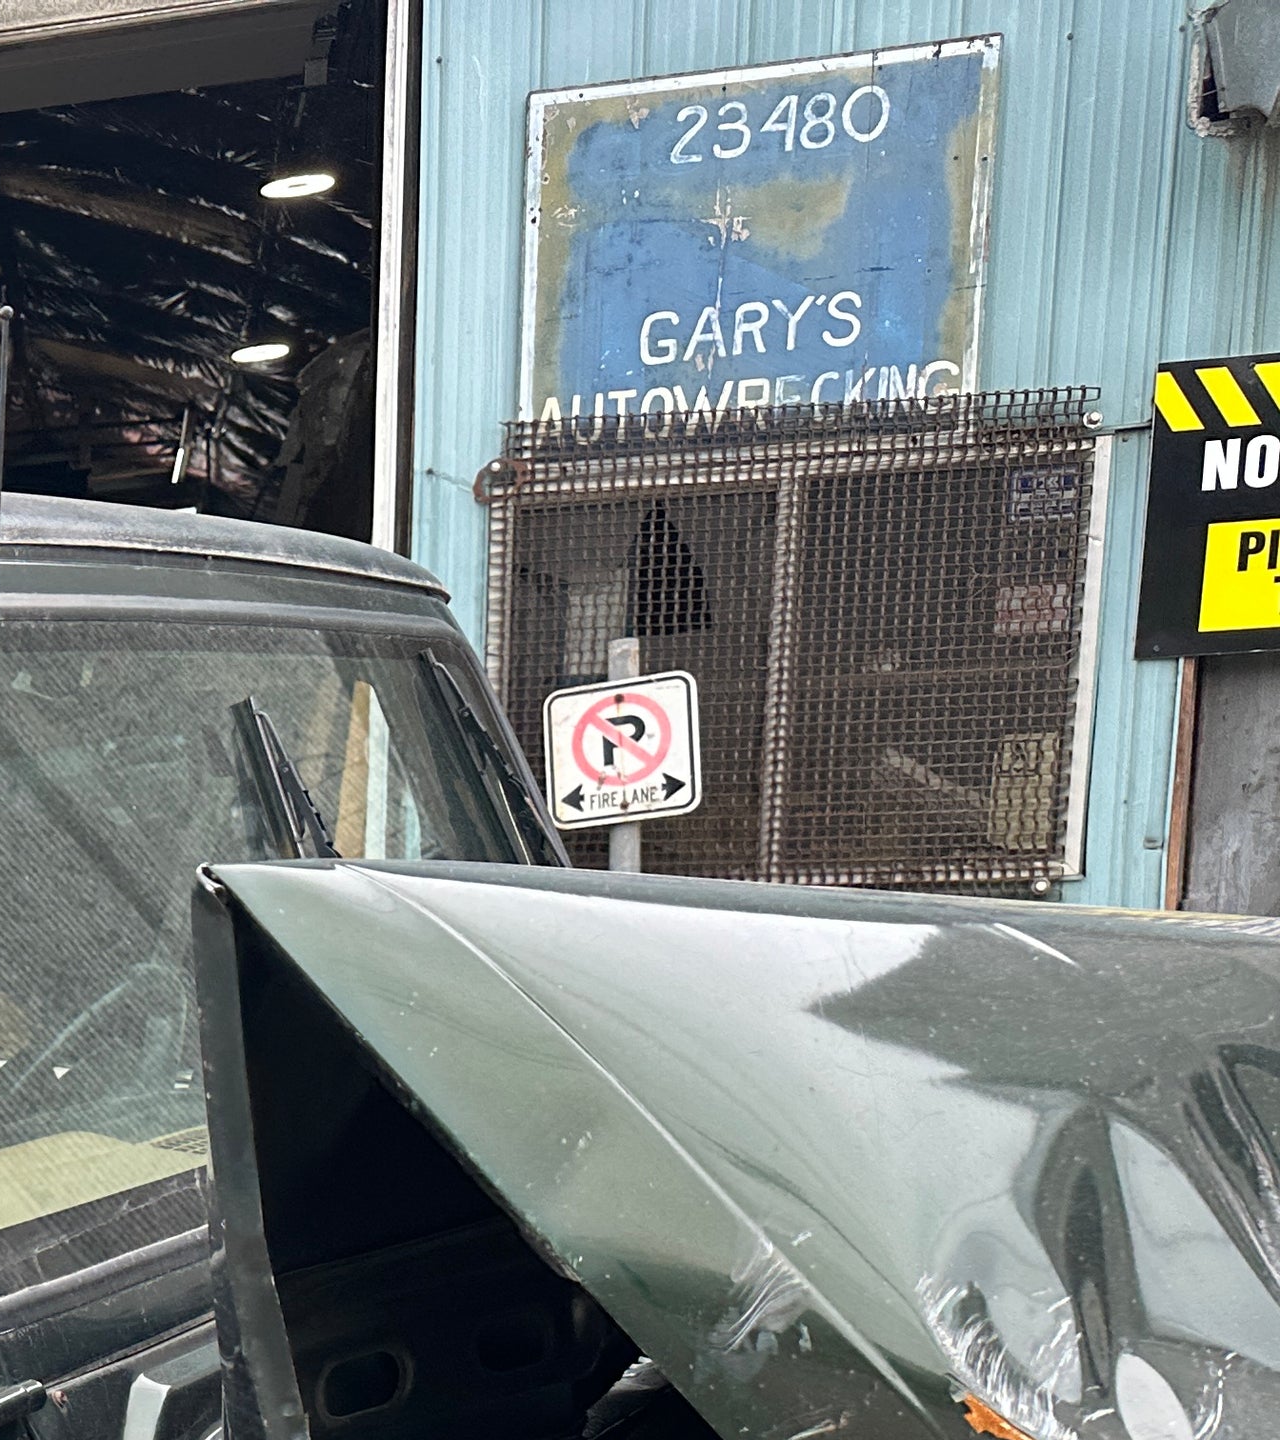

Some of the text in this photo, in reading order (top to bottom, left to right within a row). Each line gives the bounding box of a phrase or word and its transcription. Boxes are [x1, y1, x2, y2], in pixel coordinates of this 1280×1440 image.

[670, 85, 890, 164] 23480
[640, 291, 862, 366] GARY'S
[590, 786, 659, 810] FIRE LANE
